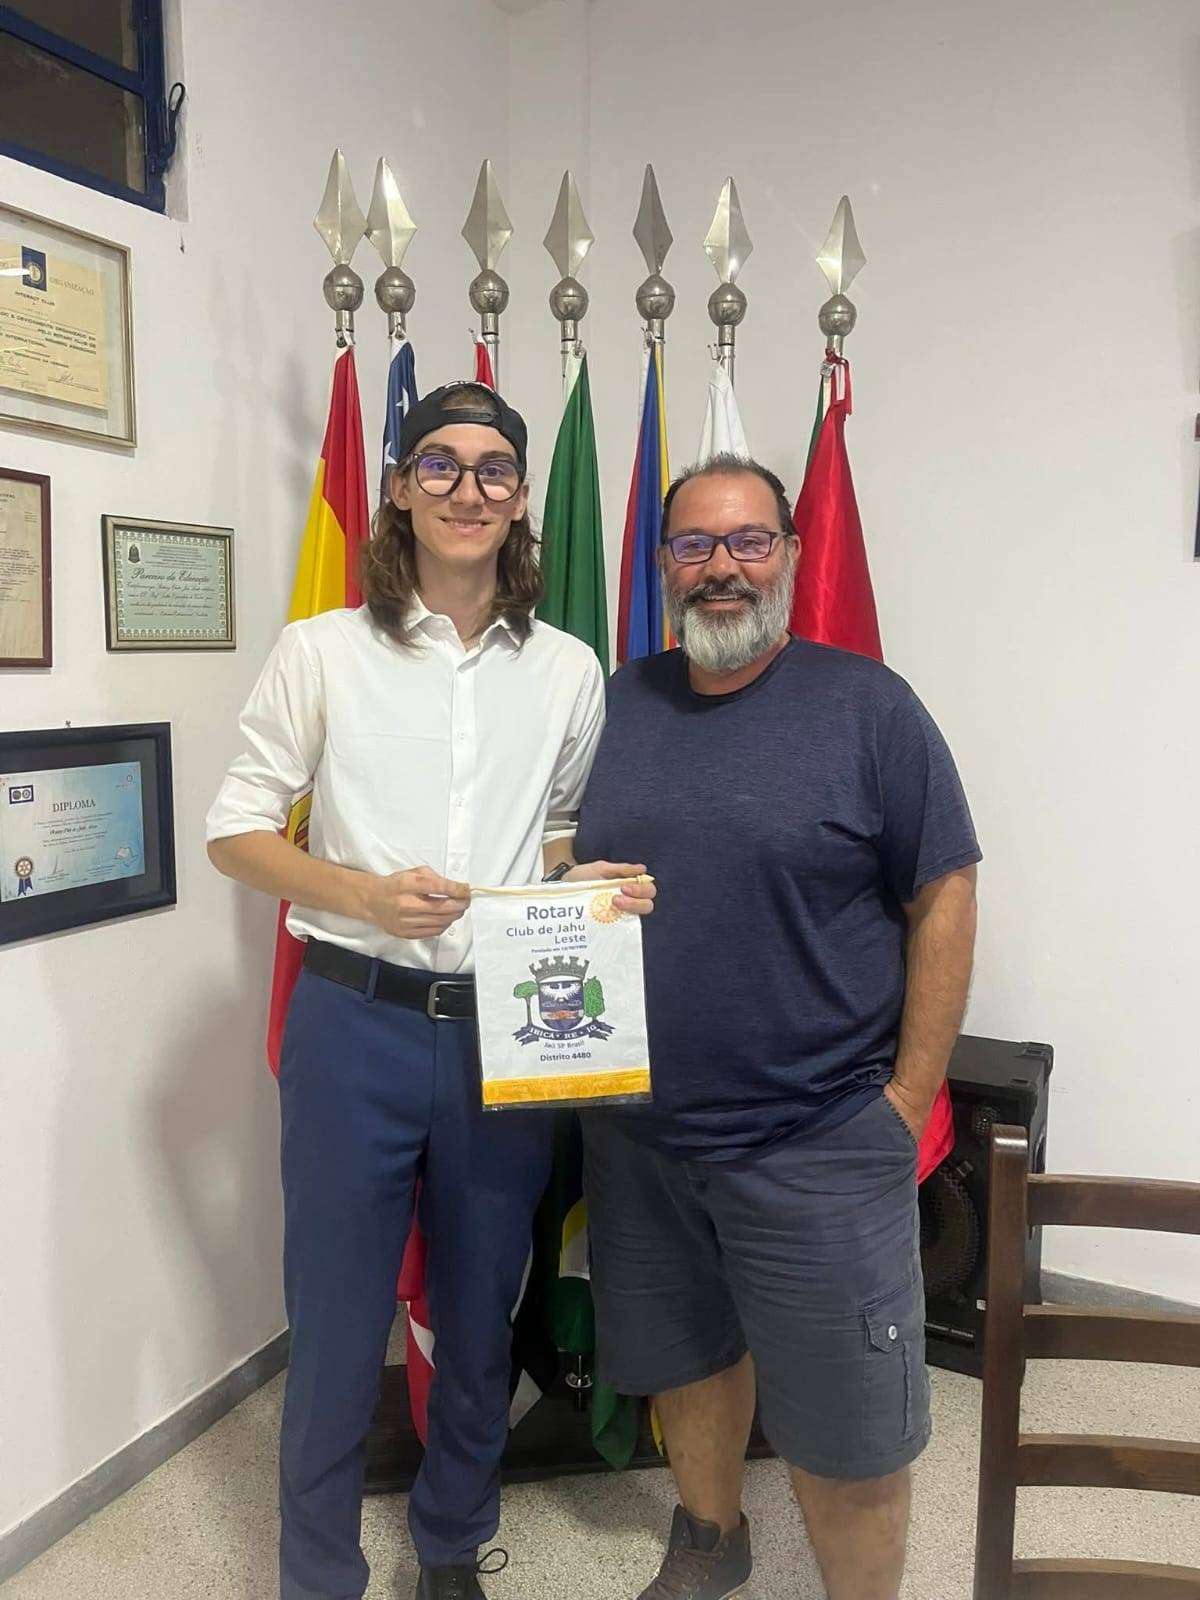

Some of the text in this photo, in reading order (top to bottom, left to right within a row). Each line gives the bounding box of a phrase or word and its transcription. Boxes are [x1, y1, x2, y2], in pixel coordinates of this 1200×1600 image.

[52, 799, 97, 813] DIPLOMA
[527, 905, 585, 921] Rotary
[506, 922, 586, 937] Club de Jahu
[554, 934, 587, 944] Leste
[540, 1053, 571, 1062] Distrito
